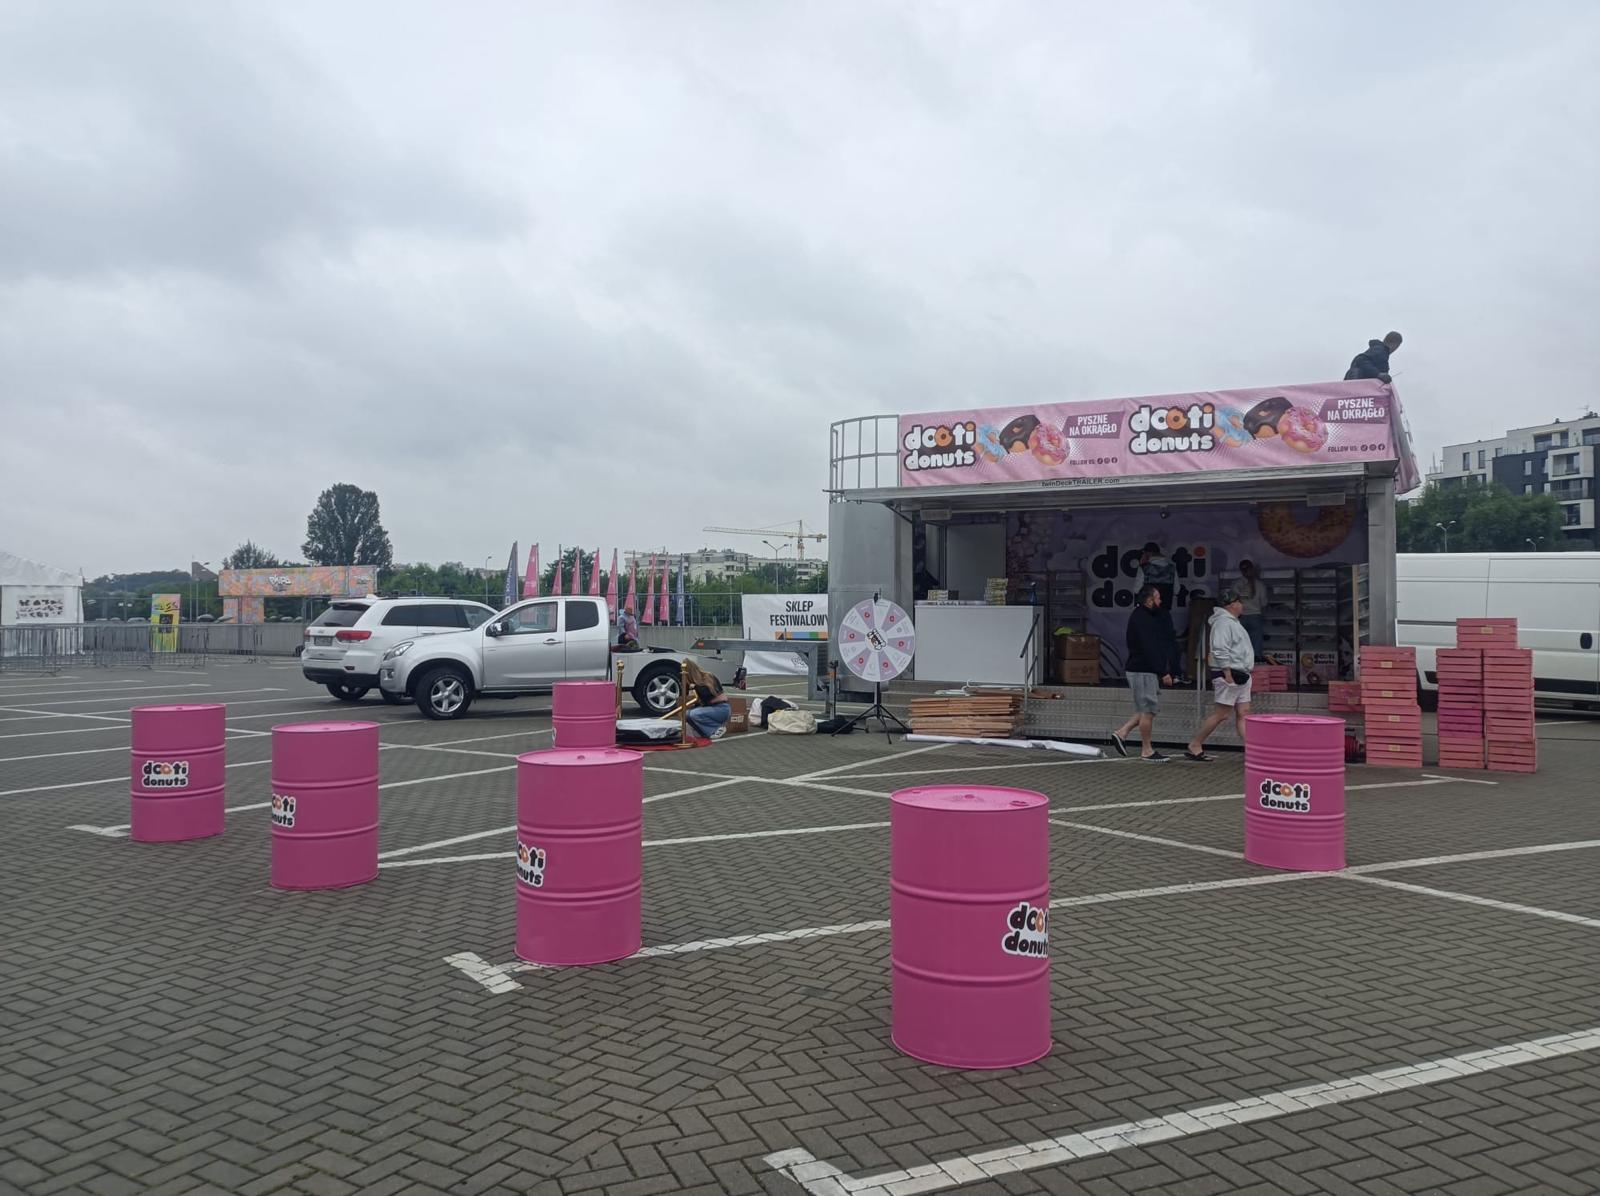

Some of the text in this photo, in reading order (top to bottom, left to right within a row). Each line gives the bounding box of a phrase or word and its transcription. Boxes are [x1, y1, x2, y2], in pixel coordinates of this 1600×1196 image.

[1337, 397, 1375, 409] PYSZNE
[1077, 414, 1108, 425] PYSZNE
[1327, 407, 1385, 421] NA OKRĄGŁO
[1069, 423, 1117, 436] NA OKRĄGŁO
[1130, 432, 1213, 453] donuts
[904, 449, 975, 470] donuts
[1091, 545, 1206, 579] doti
[785, 600, 814, 613] SKLEP
[143, 775, 187, 786] donuts
[1261, 795, 1309, 811] donuts
[1004, 930, 1048, 956] donut
